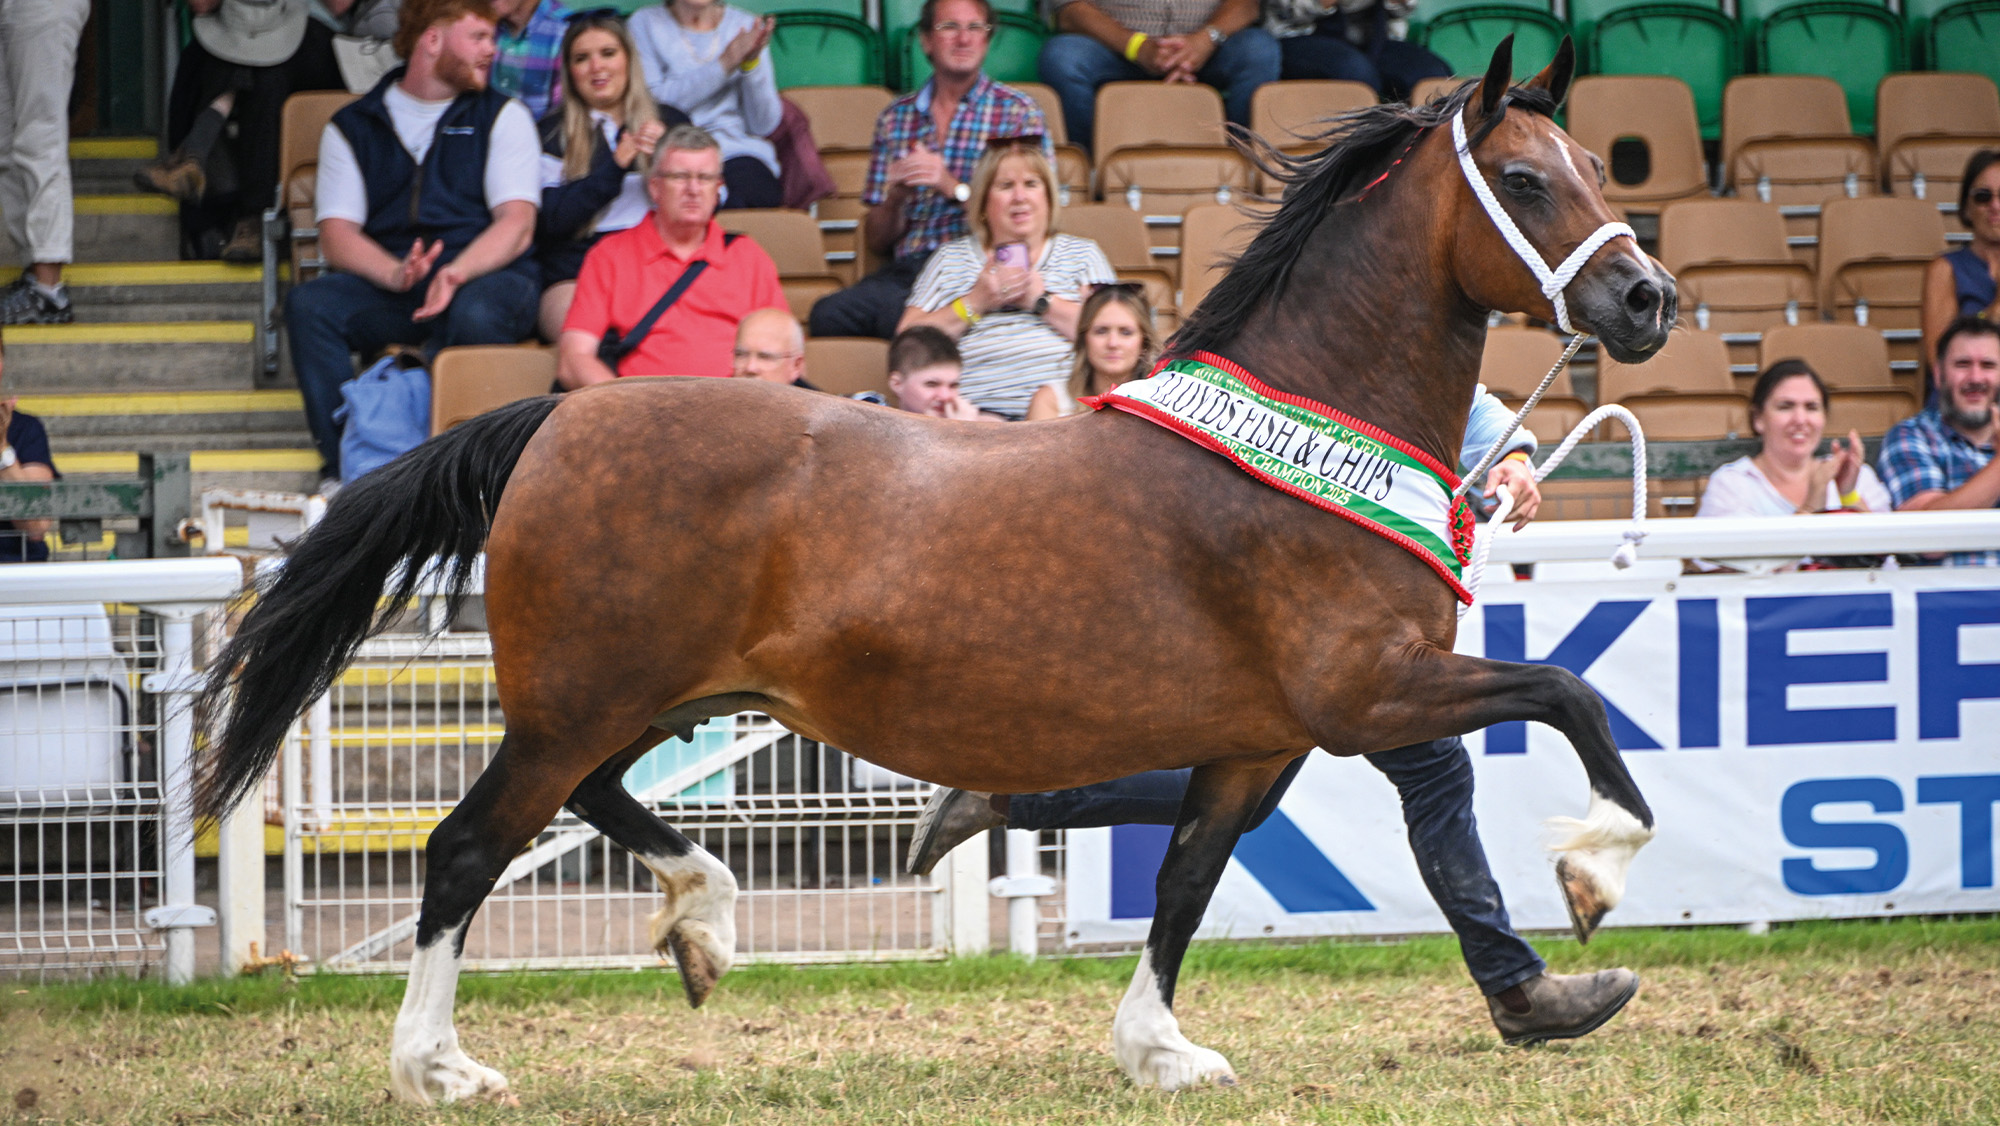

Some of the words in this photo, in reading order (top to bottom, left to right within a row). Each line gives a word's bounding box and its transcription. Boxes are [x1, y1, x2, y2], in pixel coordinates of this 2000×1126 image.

[1150, 373, 1244, 431] LLOYDS
[1231, 406, 1300, 458] FISH
[1292, 430, 1320, 468] &
[1320, 440, 1402, 502] CHIPS
[1339, 428, 1387, 458] SOCIETY
[1253, 452, 1327, 495] CHAMPION
[1322, 483, 1353, 506] 2025
